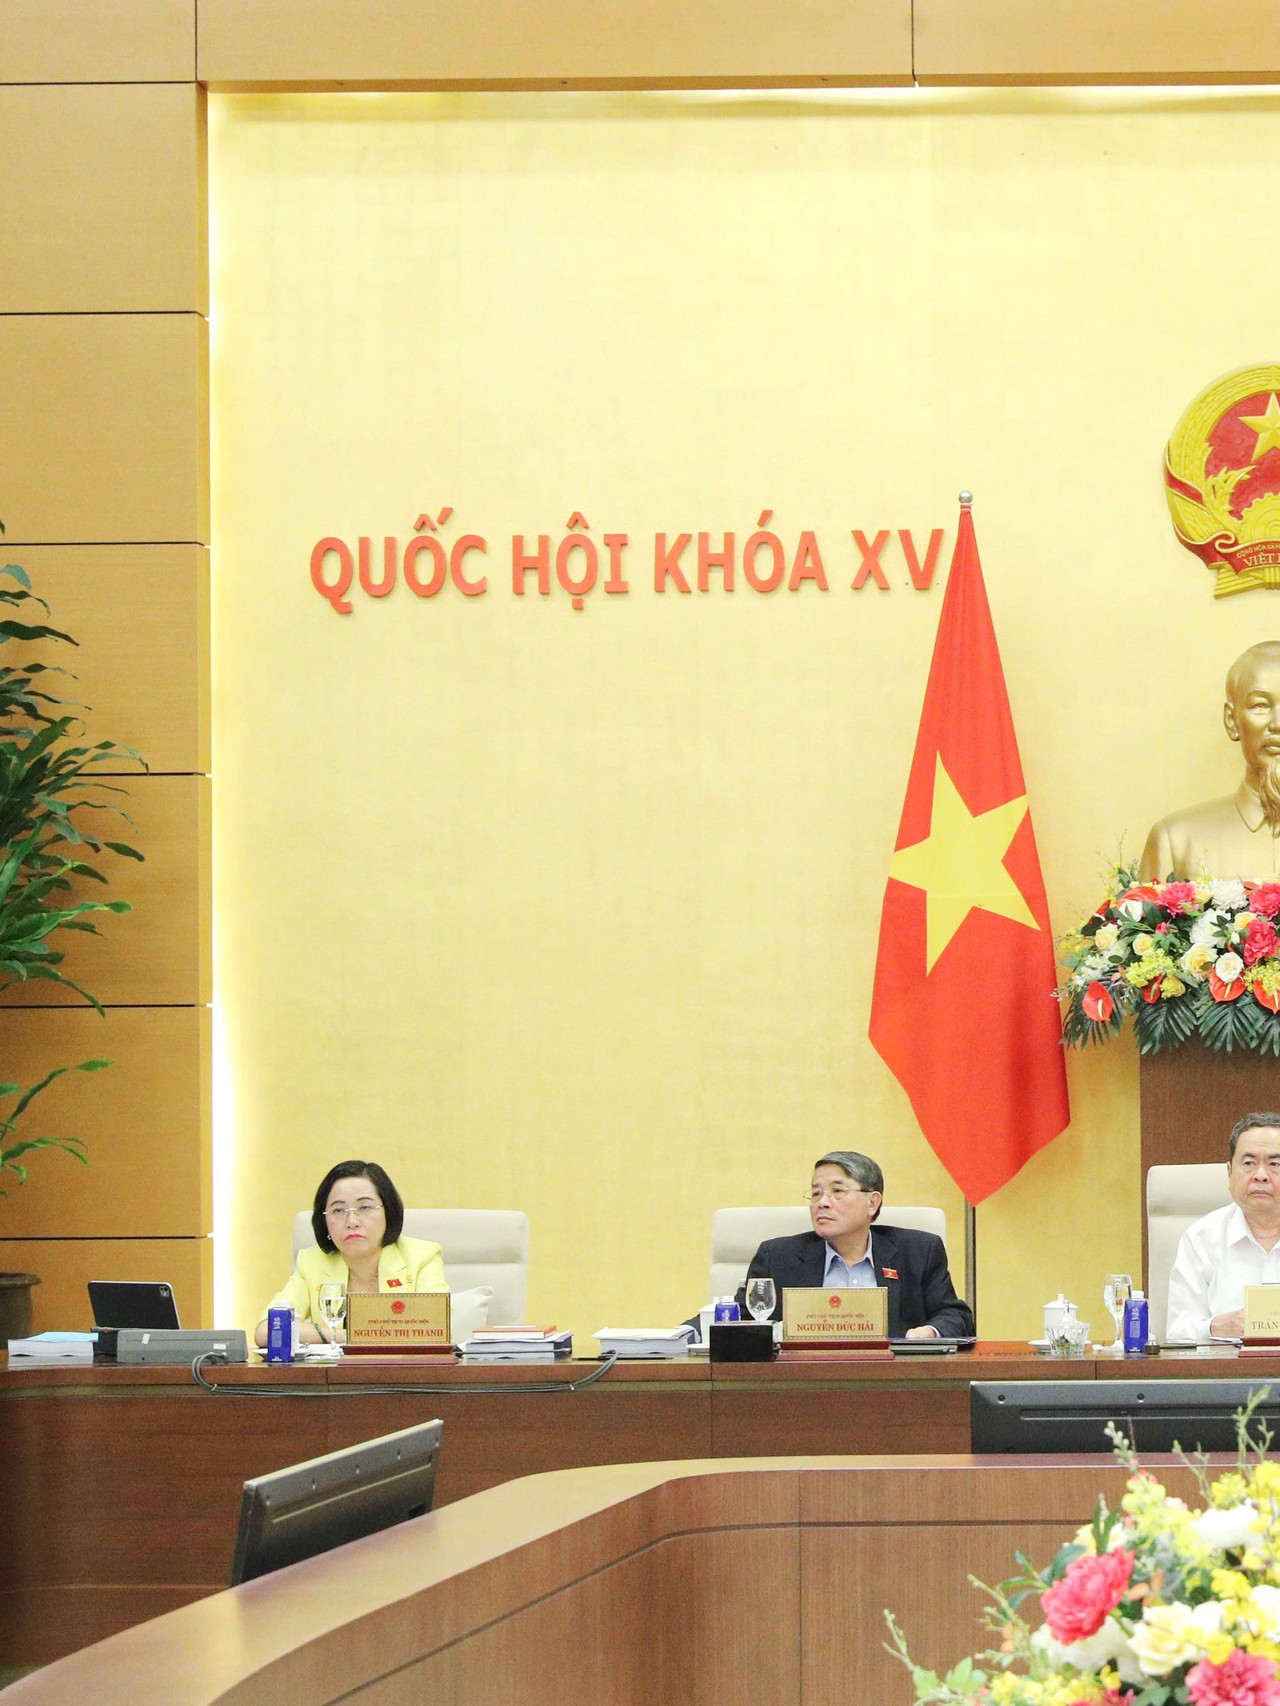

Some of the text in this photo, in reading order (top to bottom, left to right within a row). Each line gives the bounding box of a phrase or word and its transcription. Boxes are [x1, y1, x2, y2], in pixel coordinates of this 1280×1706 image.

[310, 507, 944, 614] QUỐC HỘI KHÓA XV
[394, 1329, 410, 1338] THỊ
[412, 1329, 443, 1337] THANH
